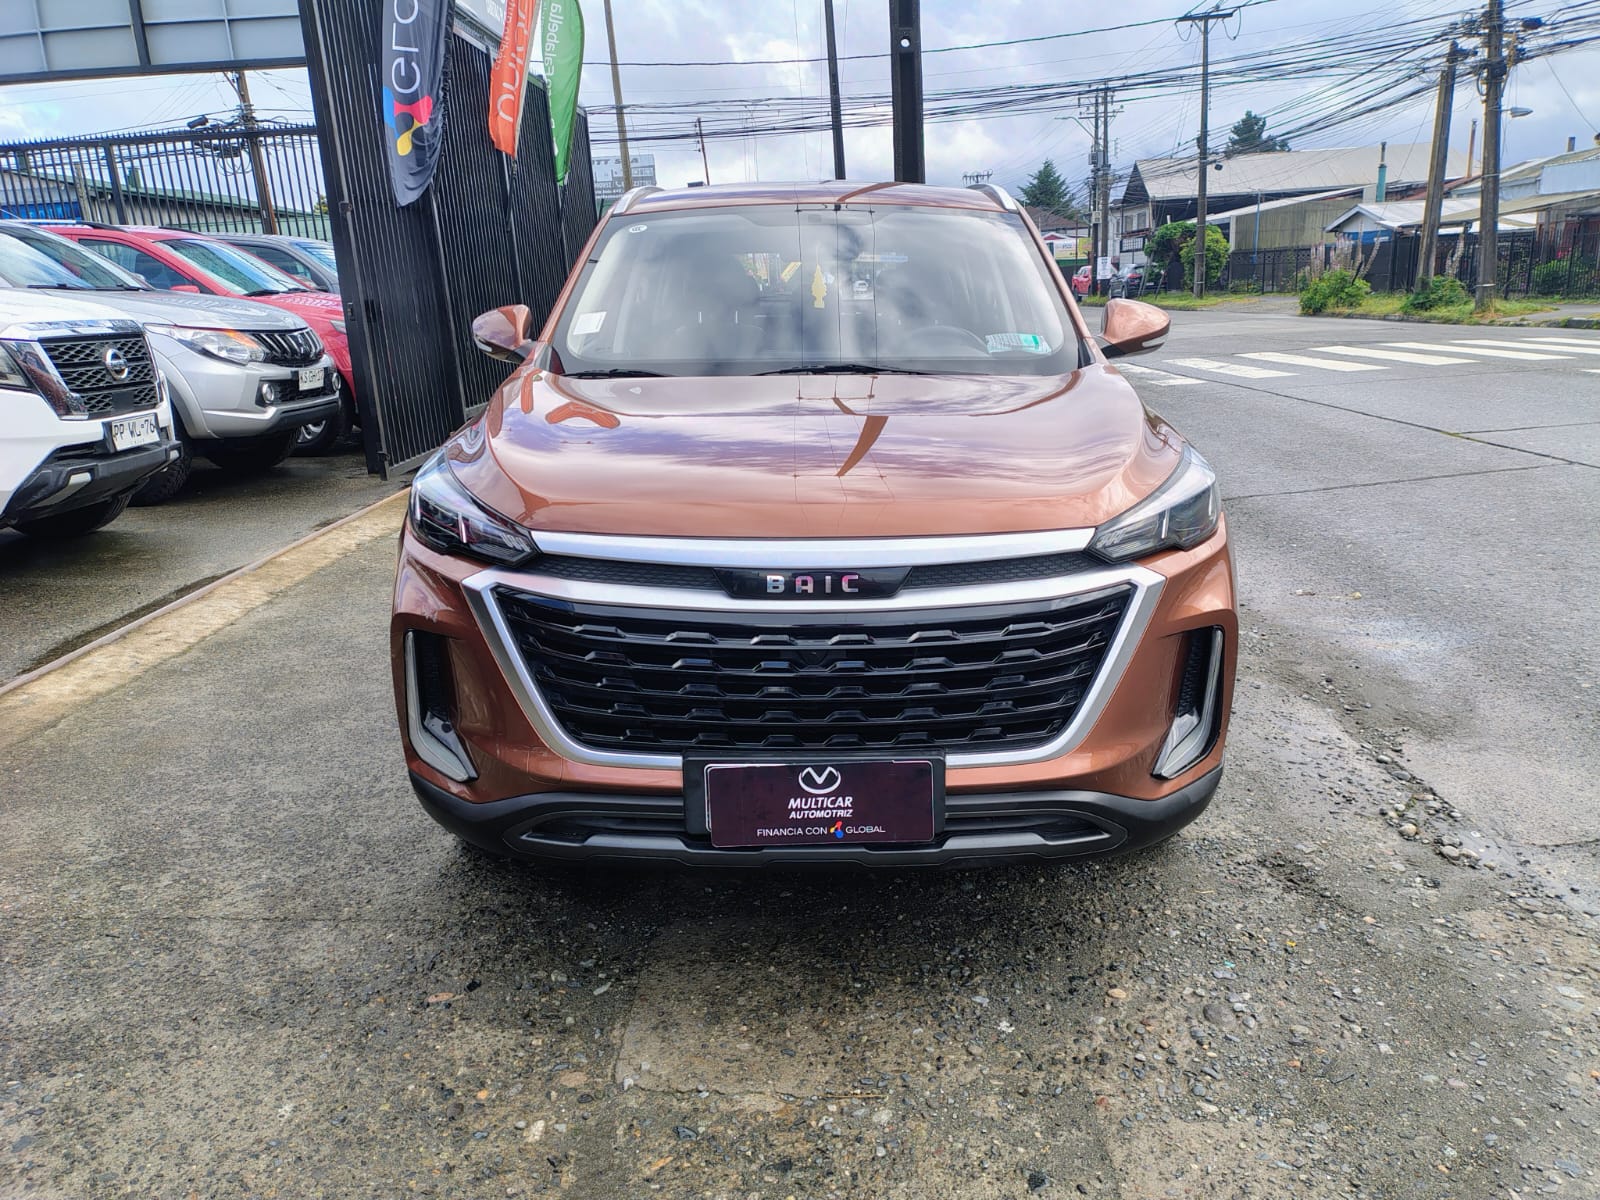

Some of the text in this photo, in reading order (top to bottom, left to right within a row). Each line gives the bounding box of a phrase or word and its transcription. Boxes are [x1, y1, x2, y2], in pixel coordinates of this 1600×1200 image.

[766, 574, 859, 594] BAIC
[787, 796, 853, 810] MULTICAR
[788, 809, 853, 819] AUTOMOTRIZ
[757, 825, 886, 837] FINANCIA CON GLOBAL
